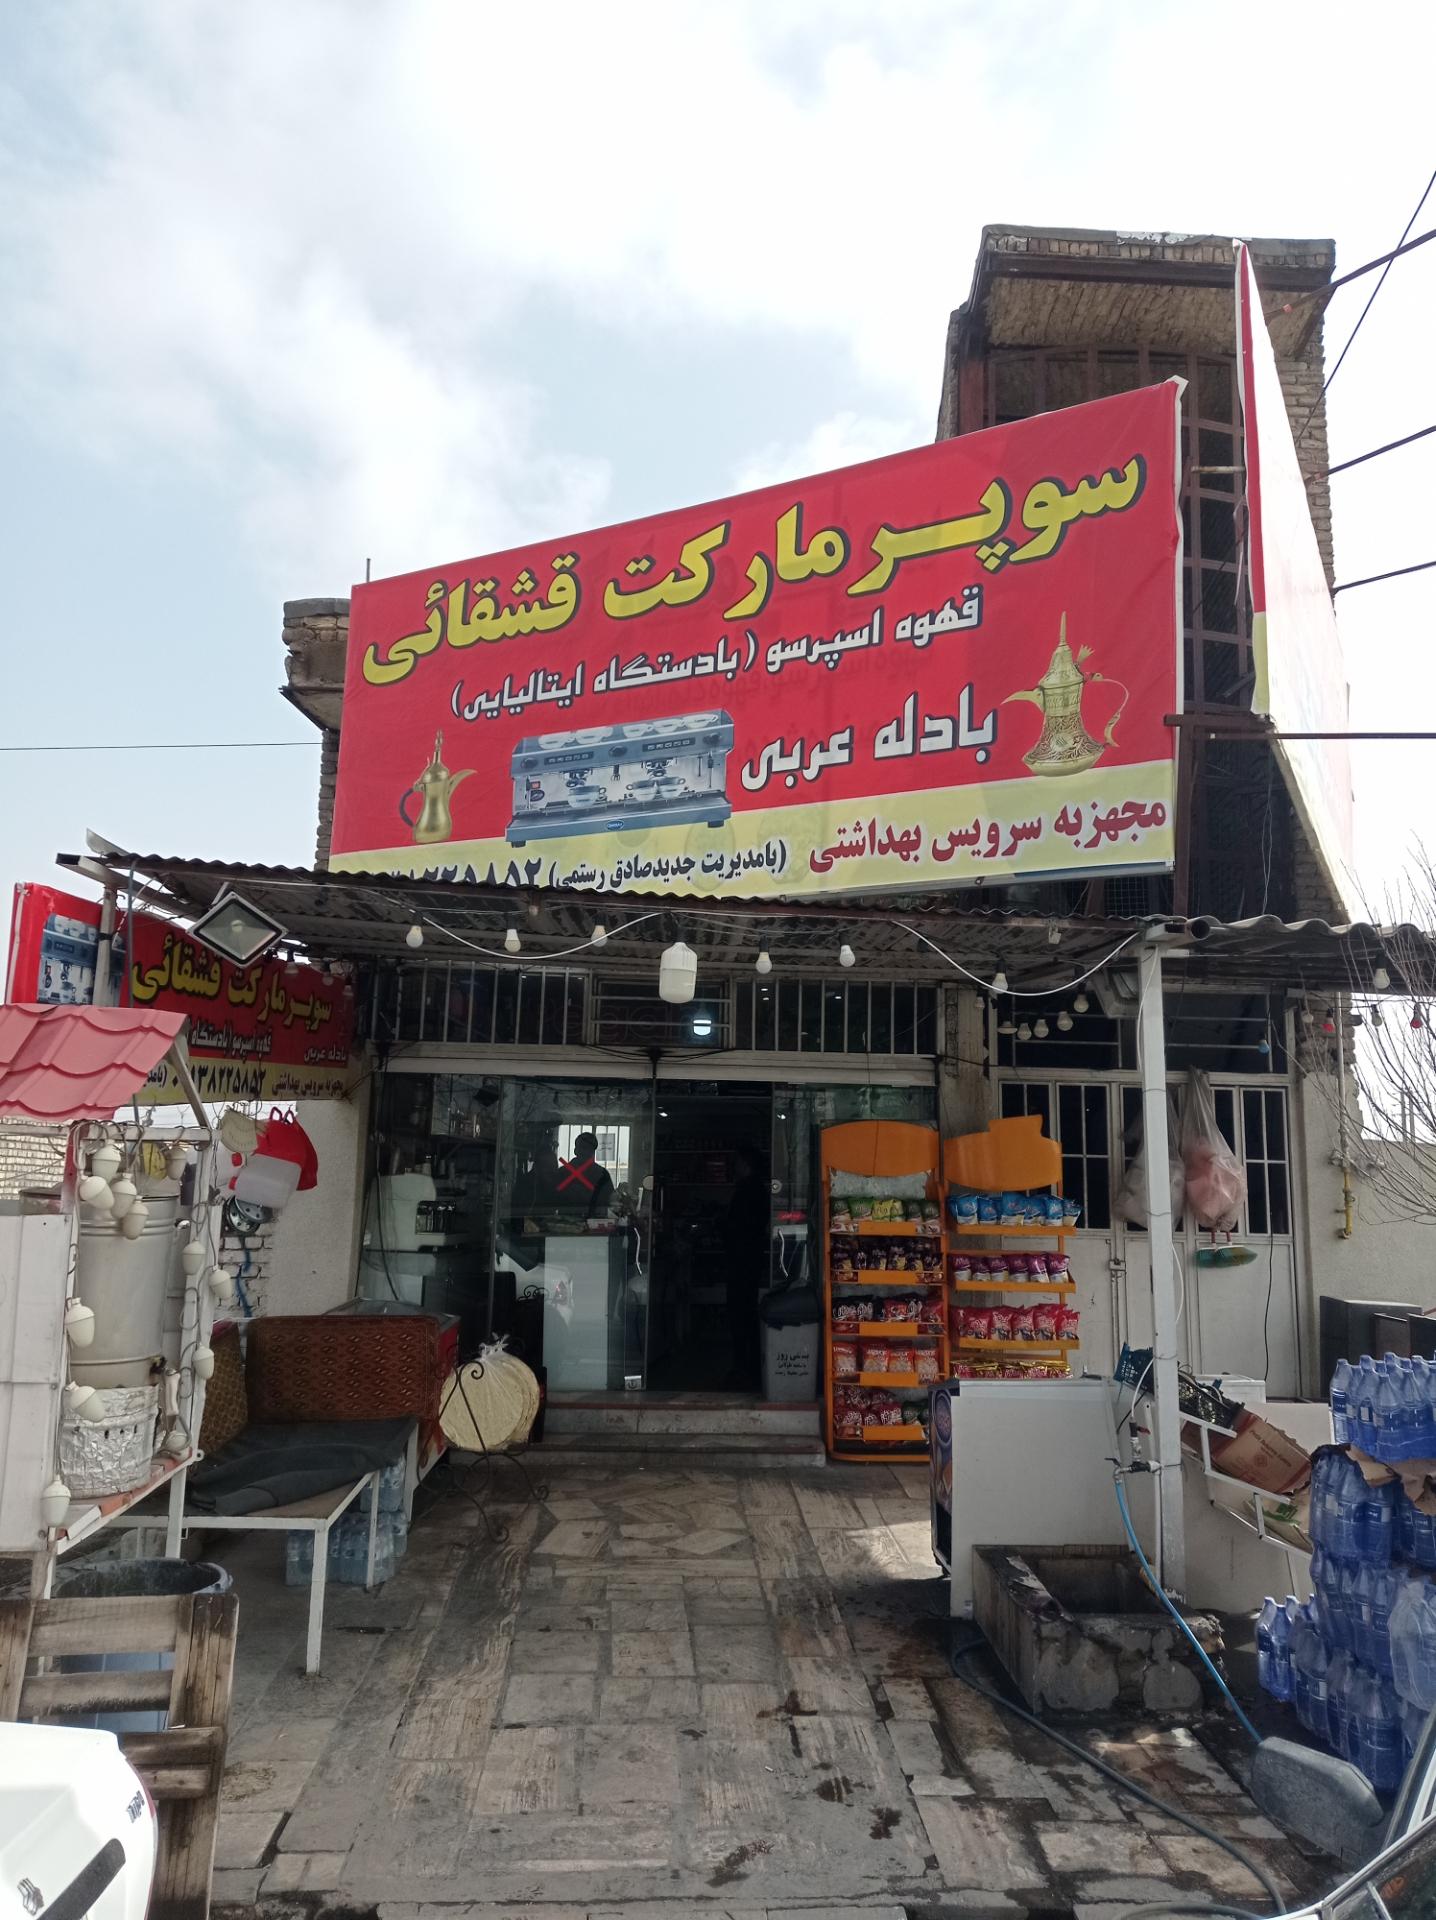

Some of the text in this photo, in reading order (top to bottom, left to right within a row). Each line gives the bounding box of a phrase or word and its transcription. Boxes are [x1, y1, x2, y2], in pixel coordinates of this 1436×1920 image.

[362, 454, 1146, 685] سوپر مارکت قشقائی
[766, 607, 883, 674] اسپرسو
[894, 584, 984, 649] قهوه
[741, 682, 998, 792] بادله عربی
[809, 817, 922, 874] بهداشتی
[931, 816, 1043, 861] سرویس
[229, 966, 285, 1023] مارکت
[282, 993, 333, 1031] سوپر
